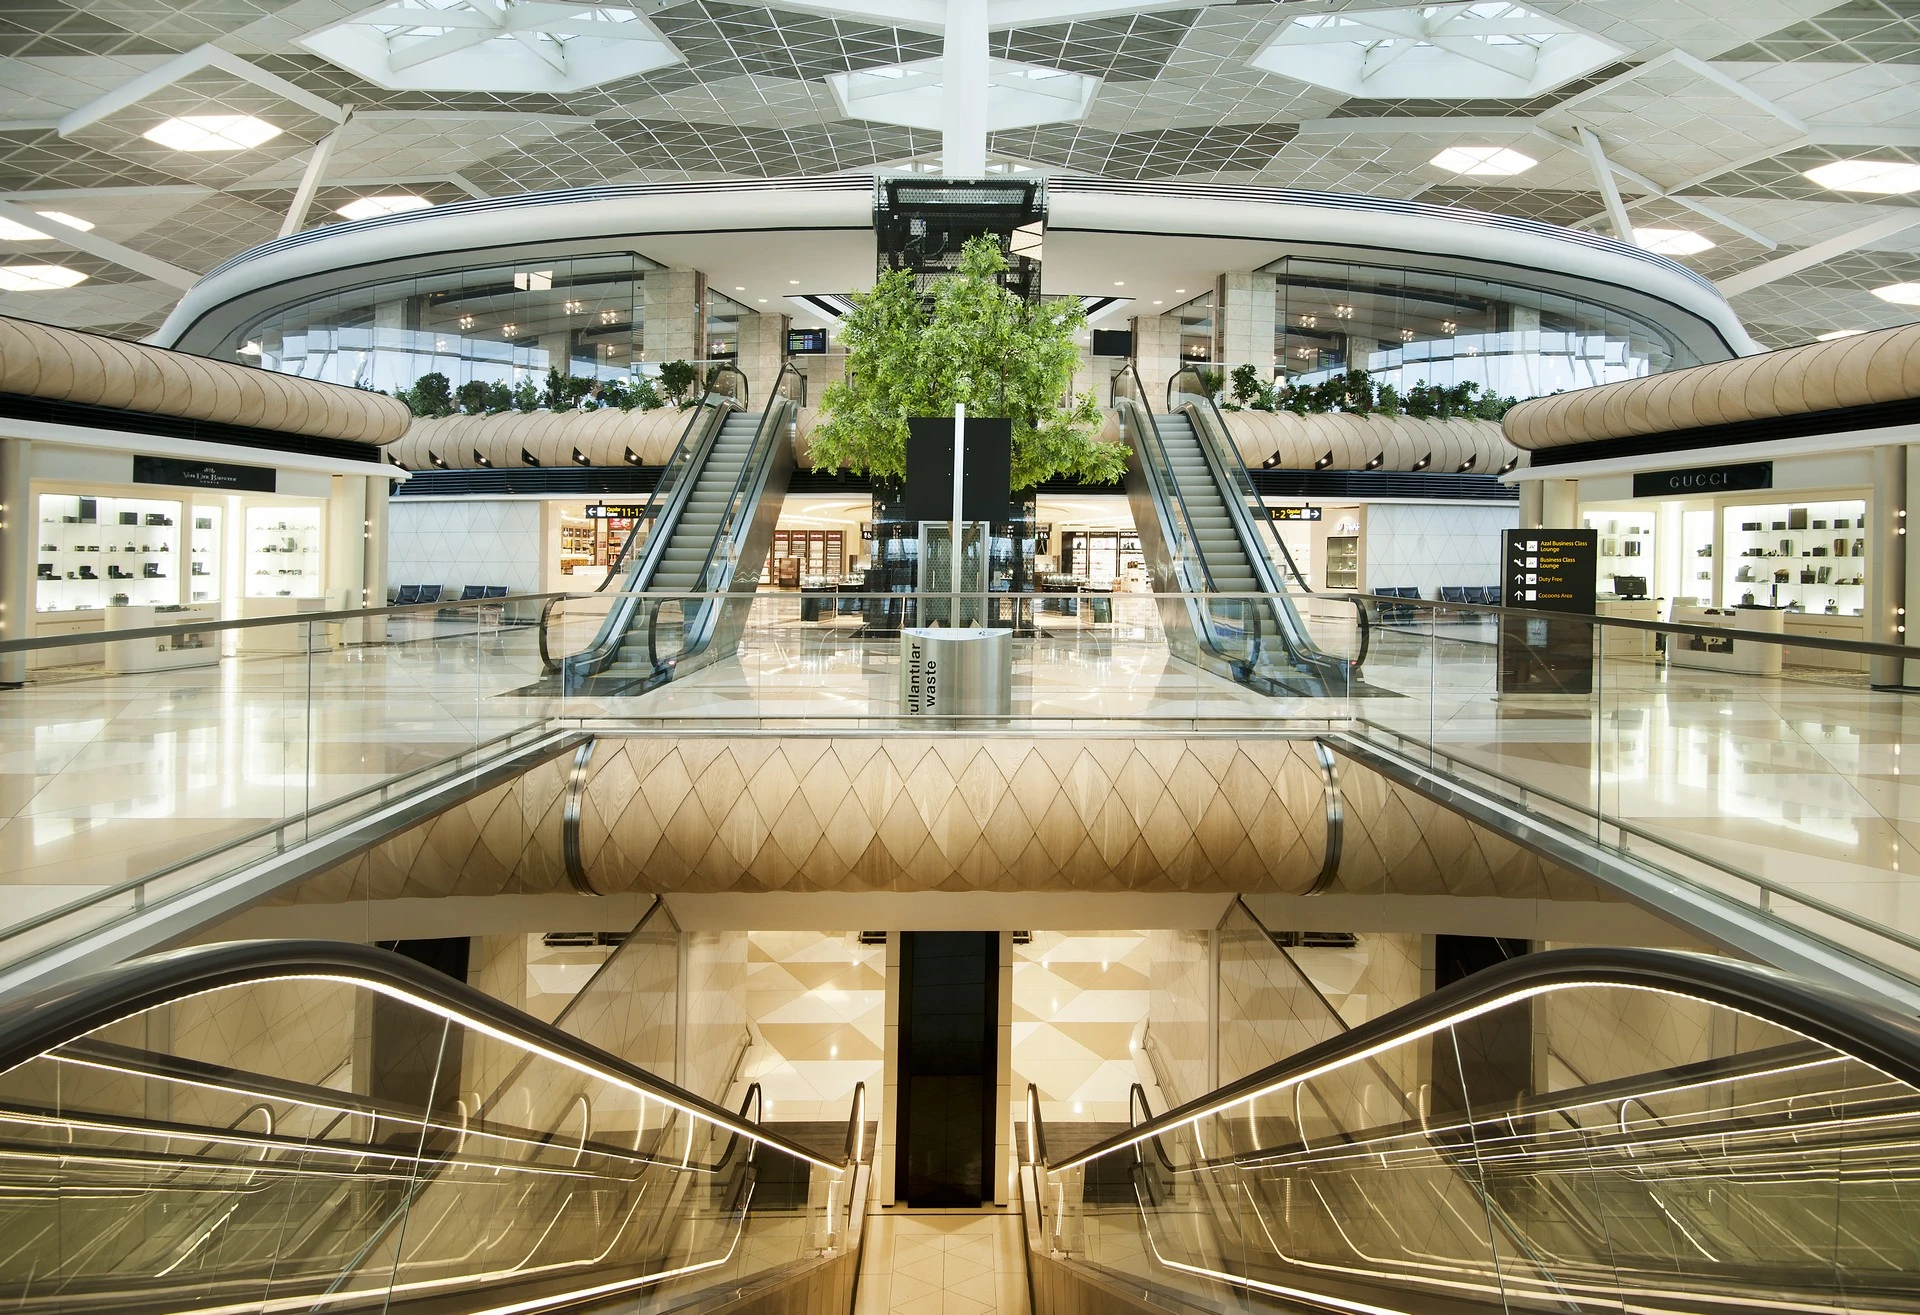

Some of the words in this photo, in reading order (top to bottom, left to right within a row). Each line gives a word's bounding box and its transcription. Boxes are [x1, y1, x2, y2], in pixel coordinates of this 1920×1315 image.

[1669, 472, 1728, 489] GUCCI
[1271, 509, 1287, 519] 1-2
[907, 643, 921, 715] ullantılar
[925, 660, 937, 707] waste
